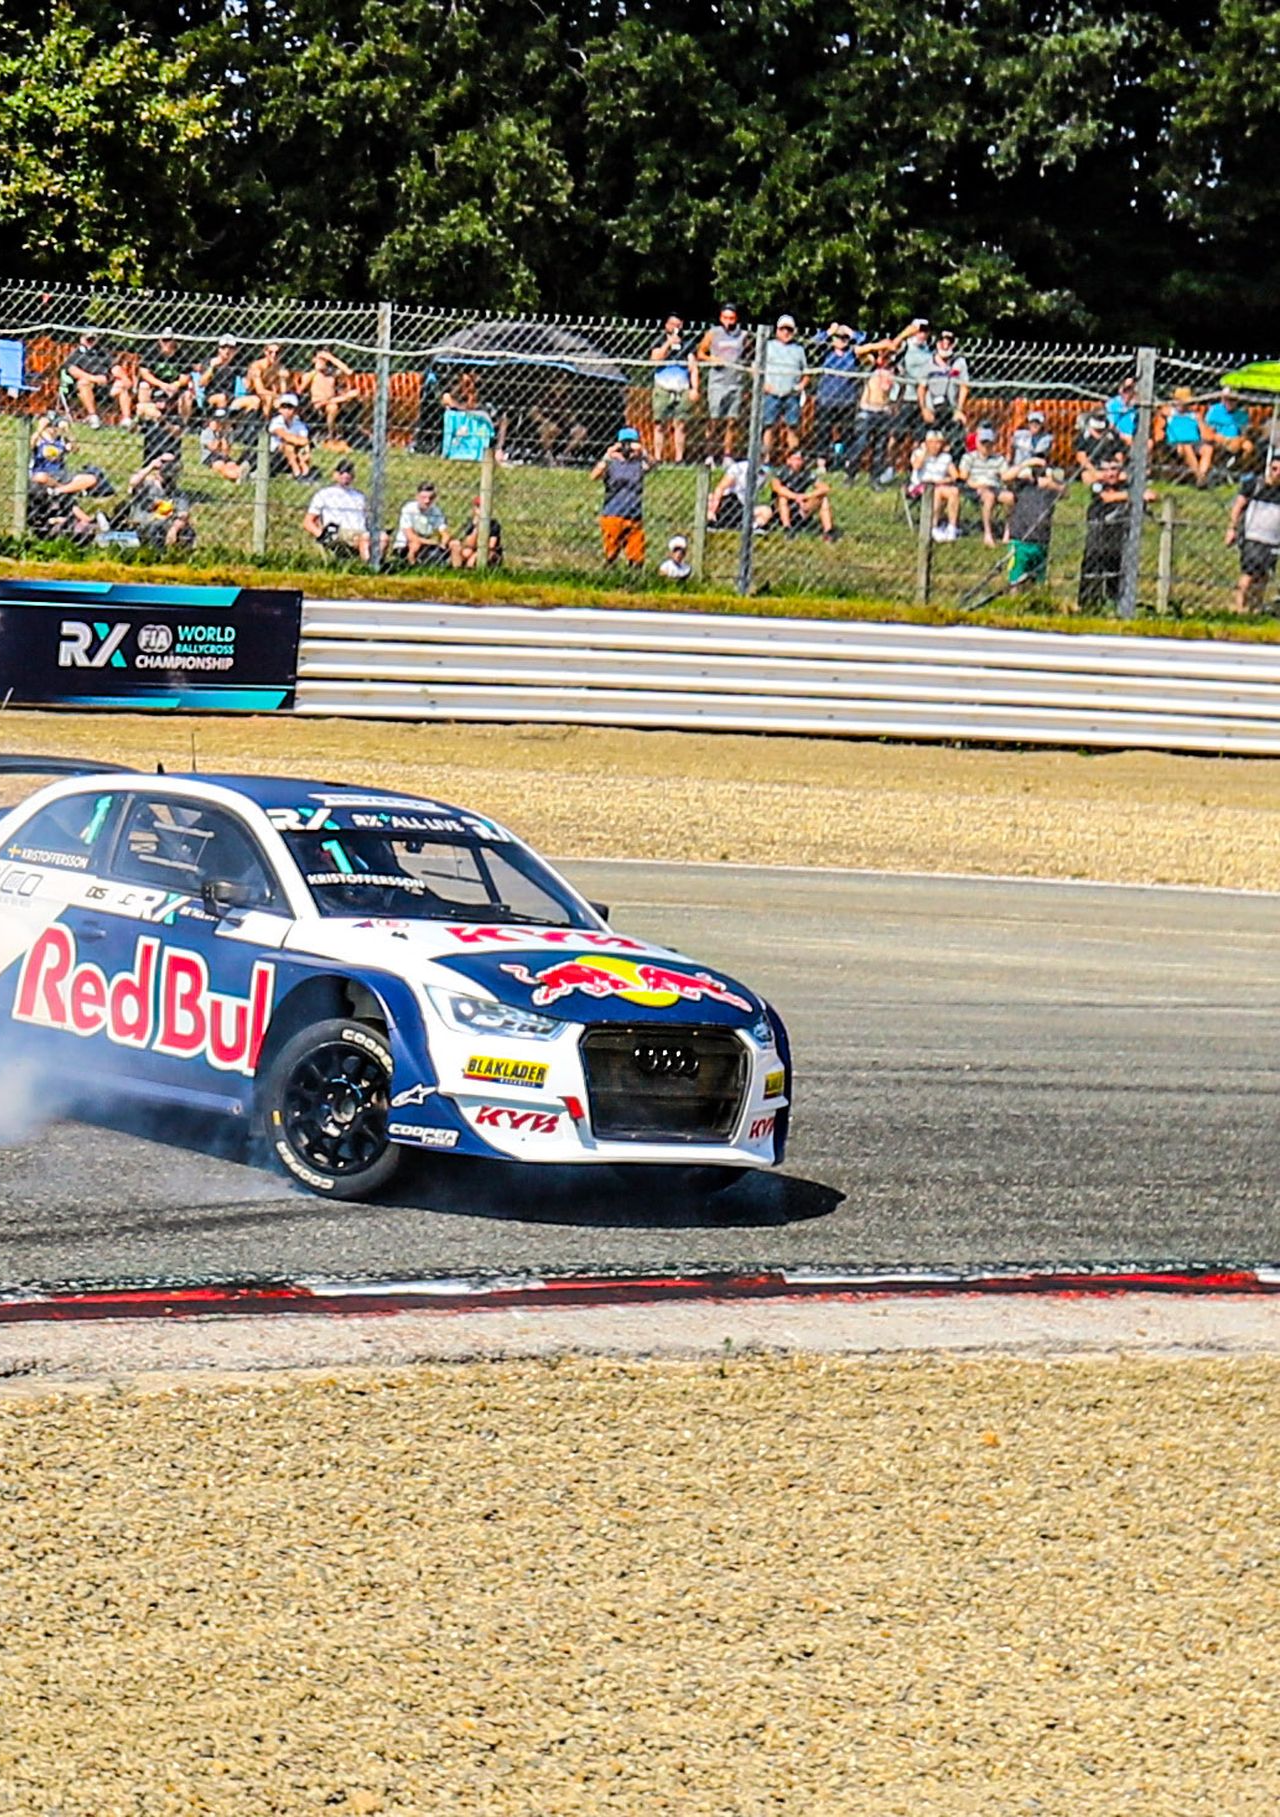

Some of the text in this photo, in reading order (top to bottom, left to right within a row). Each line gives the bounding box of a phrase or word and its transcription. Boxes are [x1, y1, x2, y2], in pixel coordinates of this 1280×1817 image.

[58, 621, 131, 668] RX
[178, 625, 237, 643] WORLD
[175, 642, 235, 655] RALLYCROSS
[135, 655, 234, 671] CHAMPIONSHIP
[266, 807, 341, 831] RX
[320, 838, 354, 875] 1
[307, 872, 425, 891] KRISTOFFERSSON
[11, 920, 277, 1077] Red Bul
[341, 1028, 393, 1075] COOPE
[389, 1123, 460, 1140] COOPER
[475, 1106, 560, 1133] KYB
[274, 1140, 335, 1190] COOPER
